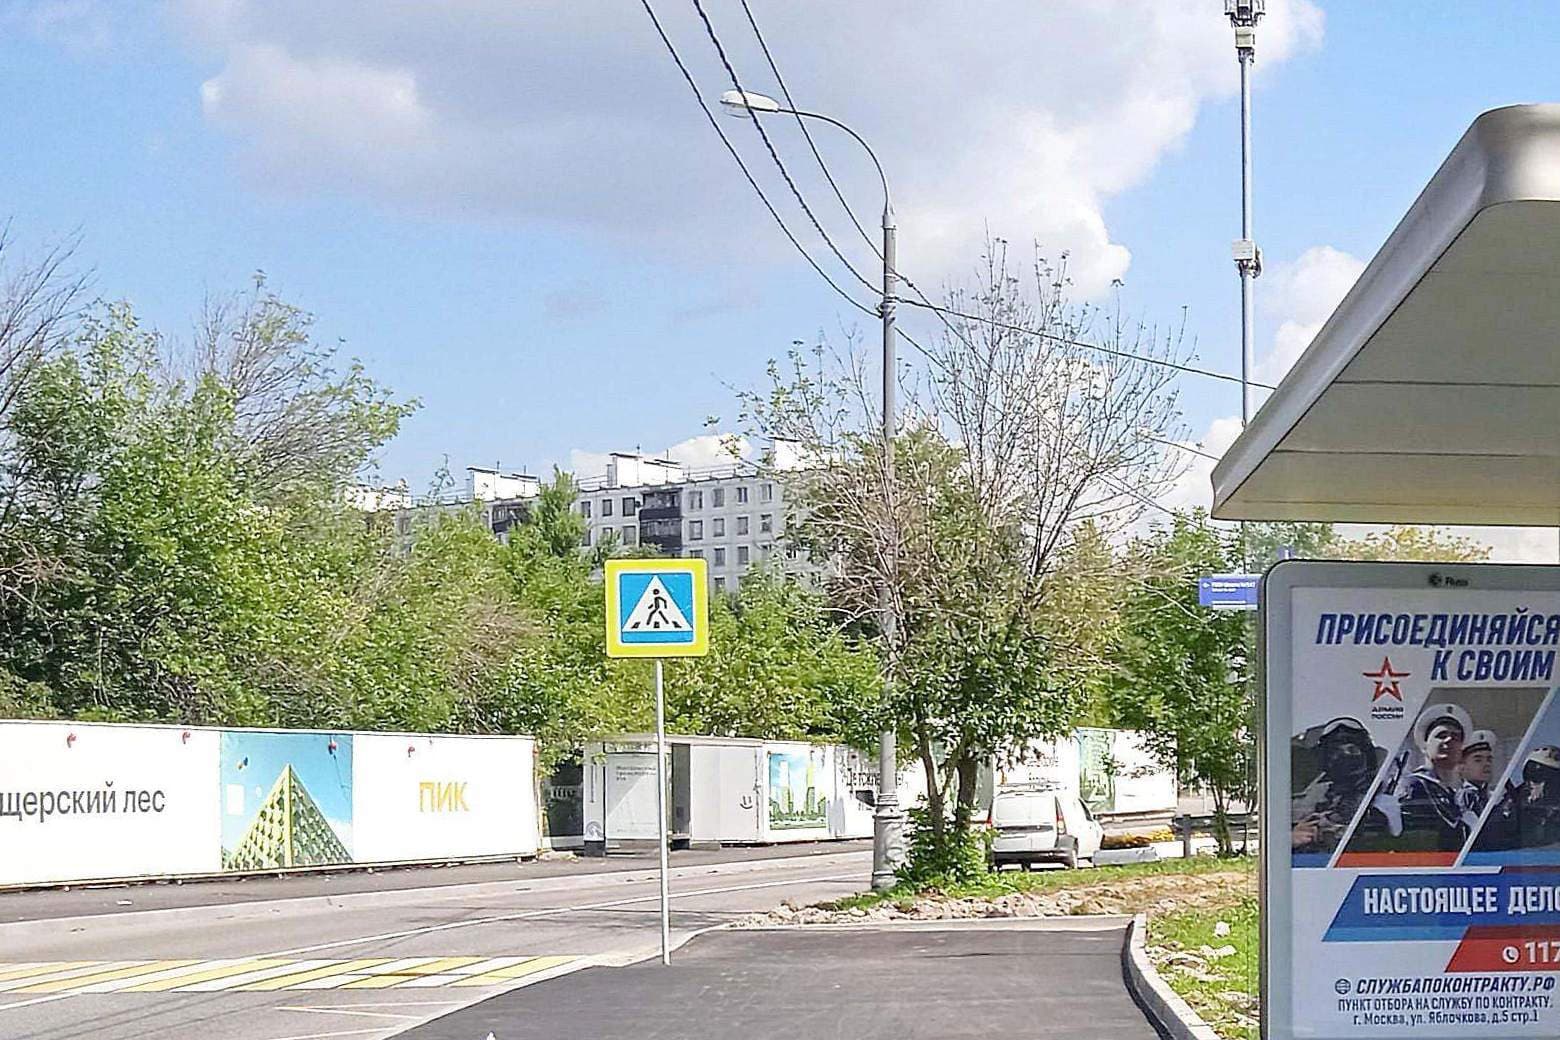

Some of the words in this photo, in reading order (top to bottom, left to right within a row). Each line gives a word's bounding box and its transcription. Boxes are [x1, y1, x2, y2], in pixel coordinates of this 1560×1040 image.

[1430, 650, 1453, 681] К
[1457, 650, 1556, 681] СВОИМ
[0, 780, 117, 823] щерский
[123, 789, 166, 814] лес
[418, 781, 470, 813] ПИК
[1364, 886, 1498, 915] НАСТОЯЩЕЕ
[1356, 976, 1556, 995] СЛУЖБАПОКОНТРАКТУ.РФ
[1338, 998, 1372, 1012] ПУНКТ
[1374, 998, 1414, 1011] ОТБОРА
[1415, 997, 1430, 1010] НА
[1431, 996, 1474, 1010] СЛУЖБУ
[1475, 996, 1490, 1009] ПО
[1492, 995, 1554, 1009] КОНТРАКТУ.
[1353, 1015, 1362, 1025] г.
[1364, 1013, 1409, 1026] Москва,
[1411, 1014, 1427, 1027] ул.
